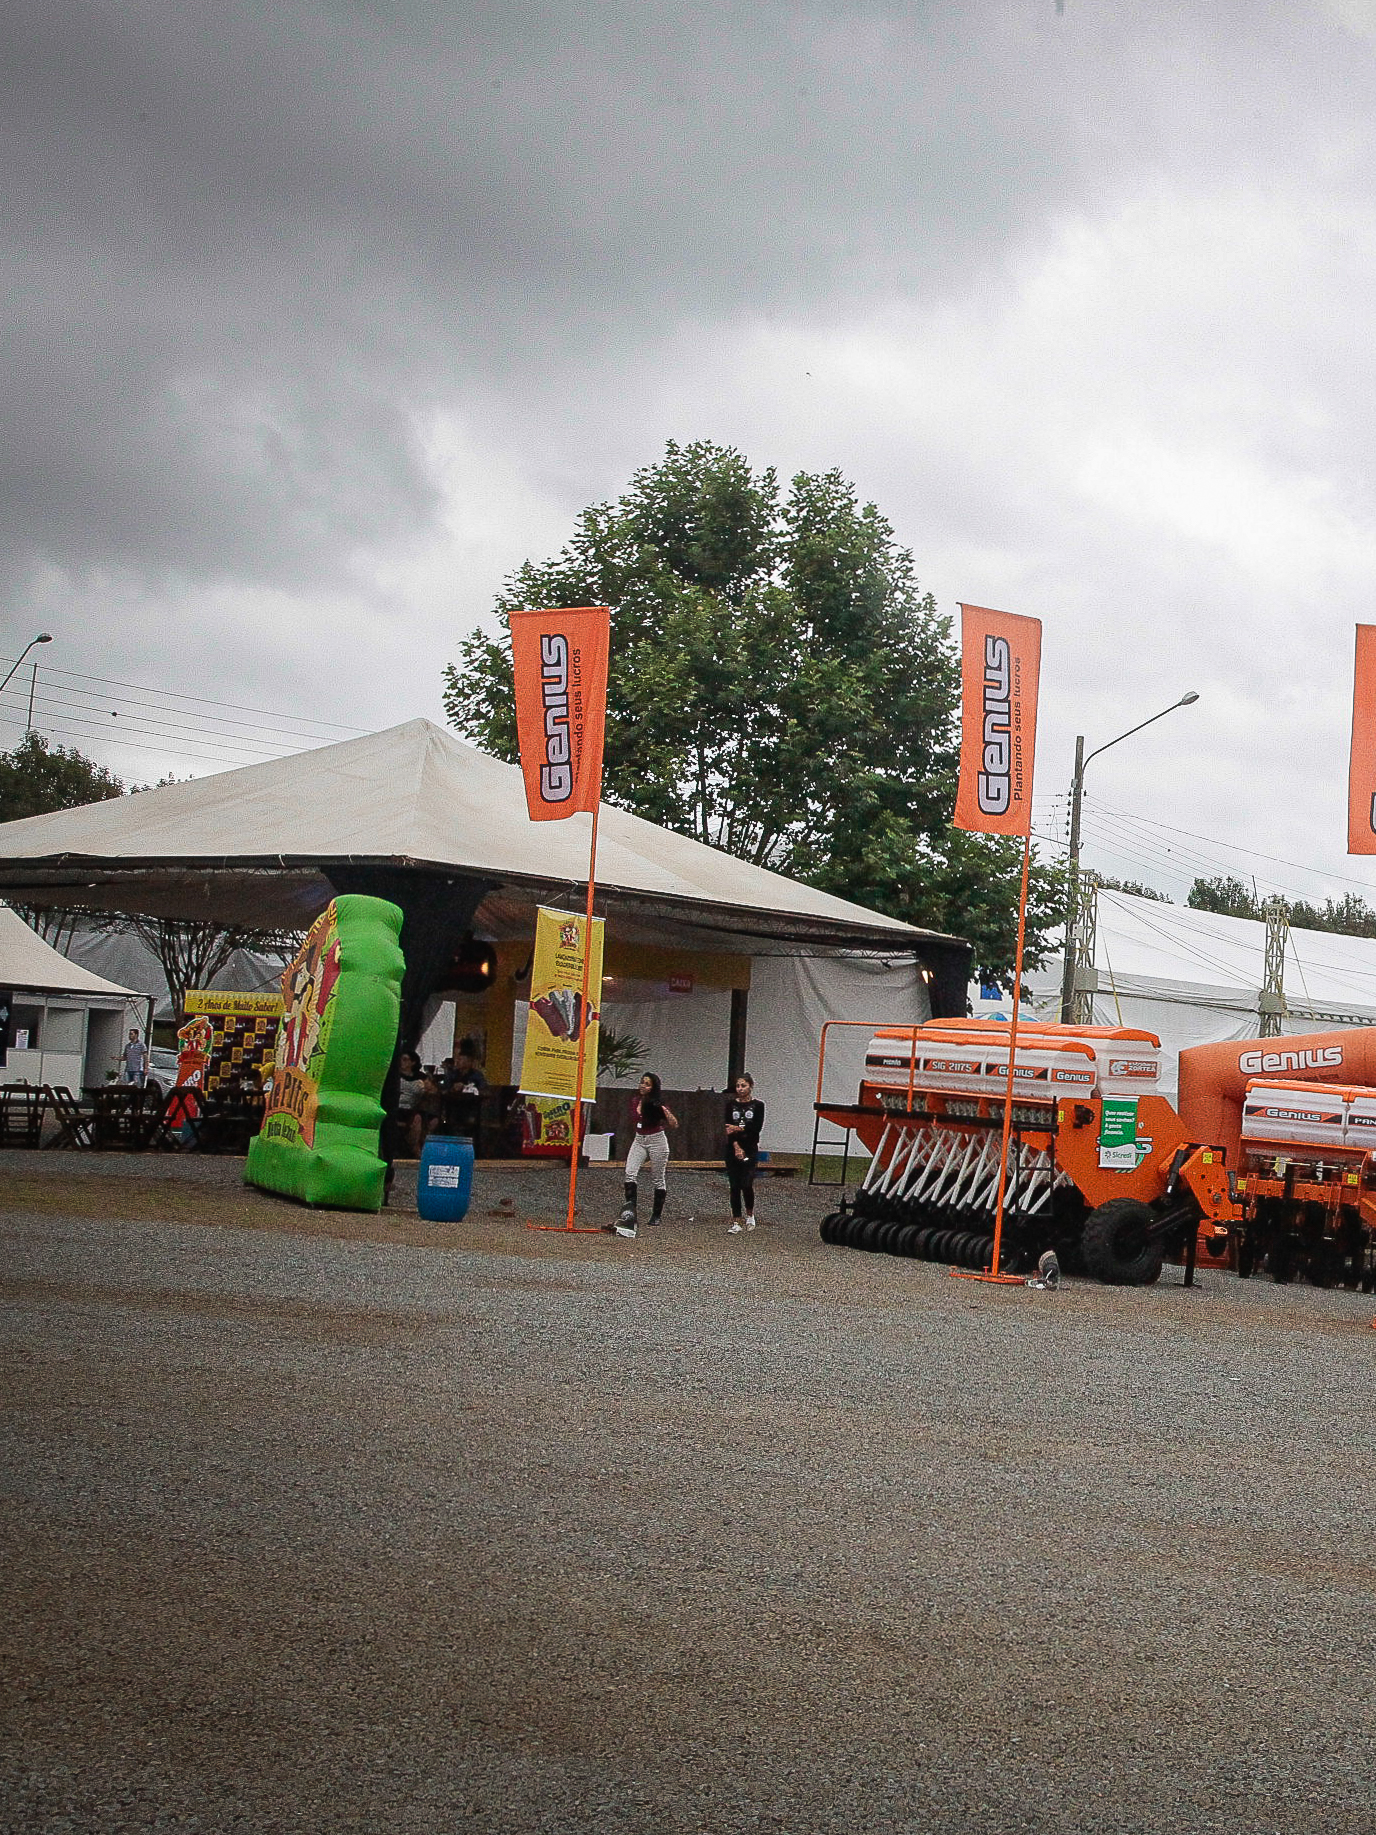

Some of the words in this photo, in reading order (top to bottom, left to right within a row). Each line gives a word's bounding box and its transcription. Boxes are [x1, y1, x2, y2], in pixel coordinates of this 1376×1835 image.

[572, 648, 581, 687] lucros
[540, 633, 572, 803] Genius
[574, 691, 582, 721] seus
[1013, 701, 1021, 732] seus
[978, 634, 1011, 815] Genius
[1013, 735, 1023, 801] Plantando
[197, 998, 204, 1009] 2
[931, 1061, 946, 1070] SIG
[1239, 1046, 1344, 1074] Genius
[1056, 1071, 1091, 1082] Genius
[1266, 1108, 1321, 1121] Genius
